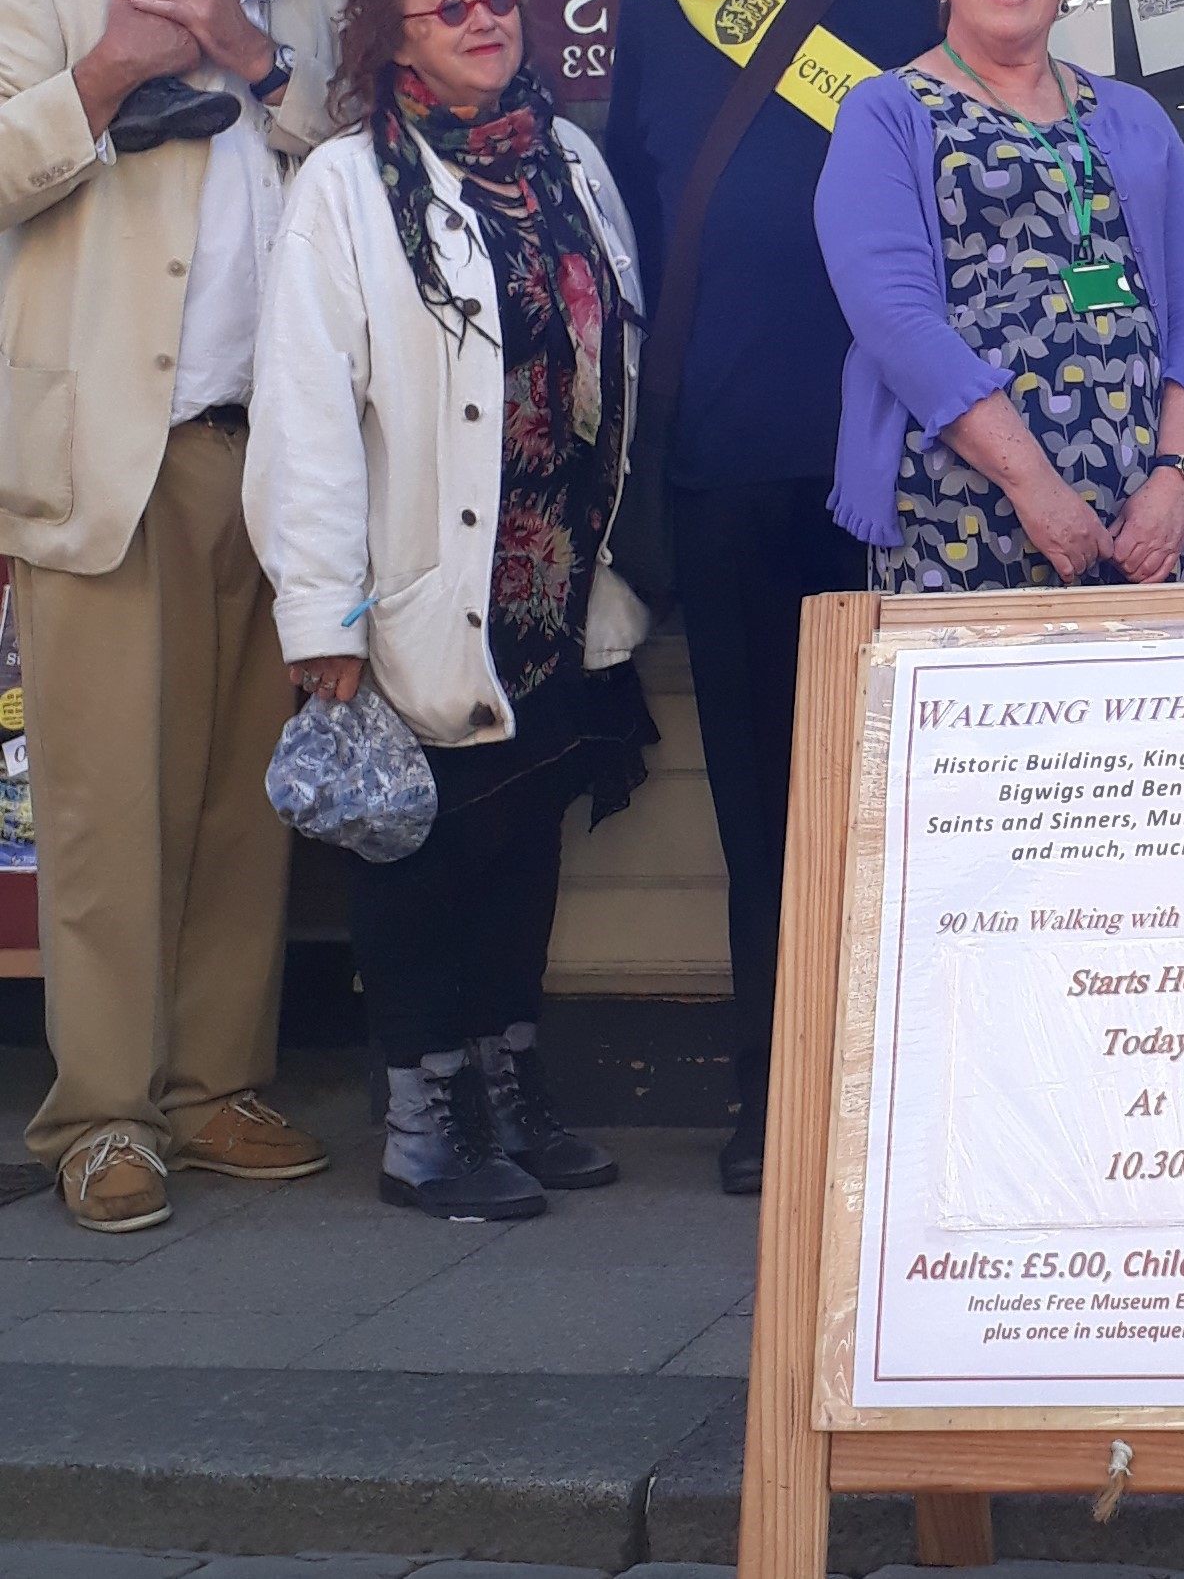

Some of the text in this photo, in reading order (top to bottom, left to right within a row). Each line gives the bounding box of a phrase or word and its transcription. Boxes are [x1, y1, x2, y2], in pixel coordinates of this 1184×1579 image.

[916, 697, 1091, 732] WALKING
[932, 754, 1018, 775] Historic
[1025, 749, 1135, 774] Buildings,
[998, 779, 1085, 806] Bigwigs
[1092, 778, 1134, 799] and
[926, 813, 994, 836] Saints
[1000, 811, 1043, 832] and
[1049, 808, 1139, 832] Sinners,
[1010, 842, 1053, 862] and
[1059, 839, 1127, 863] much,
[936, 911, 968, 935] 90
[971, 910, 1019, 933] Min
[1029, 906, 1124, 935] Walking
[1130, 905, 1180, 929] with
[1066, 968, 1151, 998] Starts
[1124, 1089, 1167, 1117] At
[905, 1252, 1013, 1281] Adults:
[1020, 1250, 1114, 1283] £5.00,
[967, 1293, 1042, 1313] Includes
[1046, 1294, 1086, 1312] Free
[1089, 1293, 1170, 1312] Museum
[982, 1321, 1022, 1344] plus
[1025, 1325, 1068, 1341] once
[1072, 1322, 1092, 1340] in
